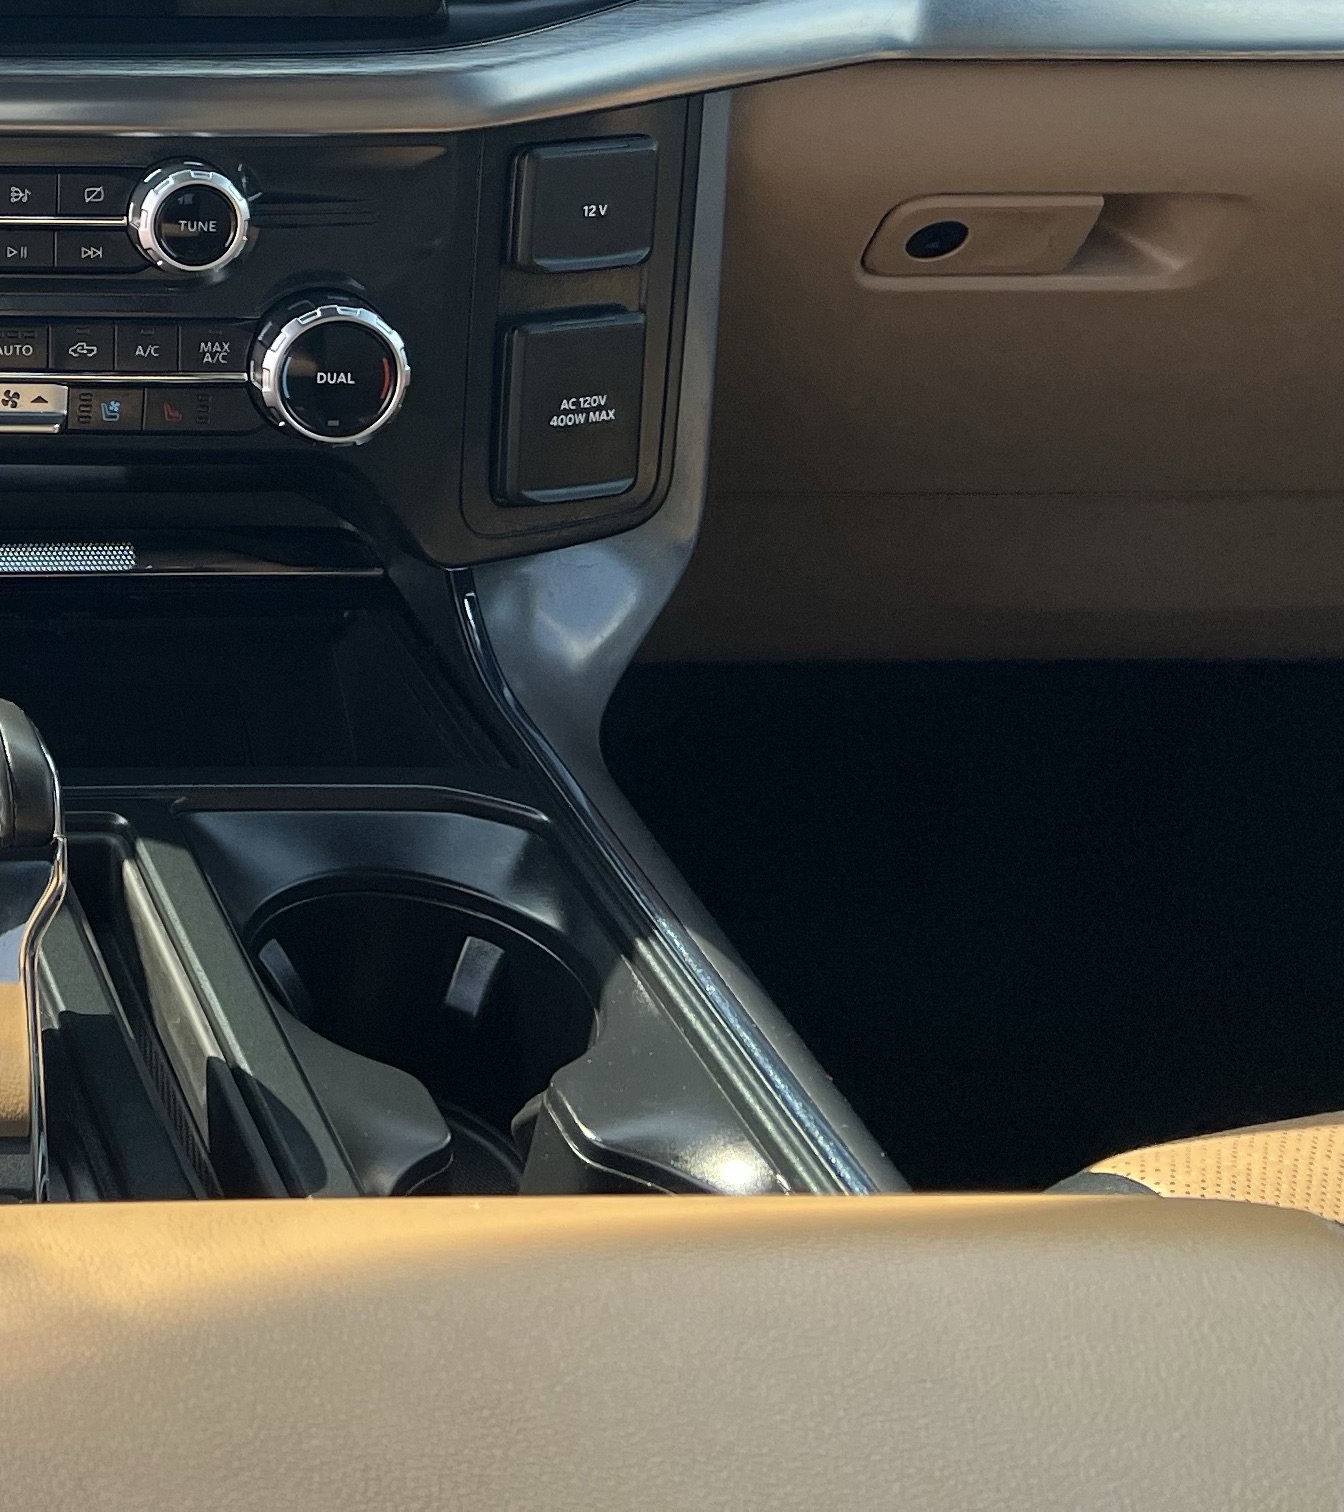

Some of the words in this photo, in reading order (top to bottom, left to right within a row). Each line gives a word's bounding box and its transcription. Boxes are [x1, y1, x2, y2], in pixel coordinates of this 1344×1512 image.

[178, 220, 217, 233] TUNE
[135, 345, 160, 357] A/C
[199, 341, 231, 353] MAX
[202, 352, 228, 364] A/C
[316, 372, 355, 384] DUAL
[560, 398, 577, 411] AC
[579, 395, 608, 408] 120V
[549, 413, 587, 427] 400W
[589, 409, 616, 422] MAX
